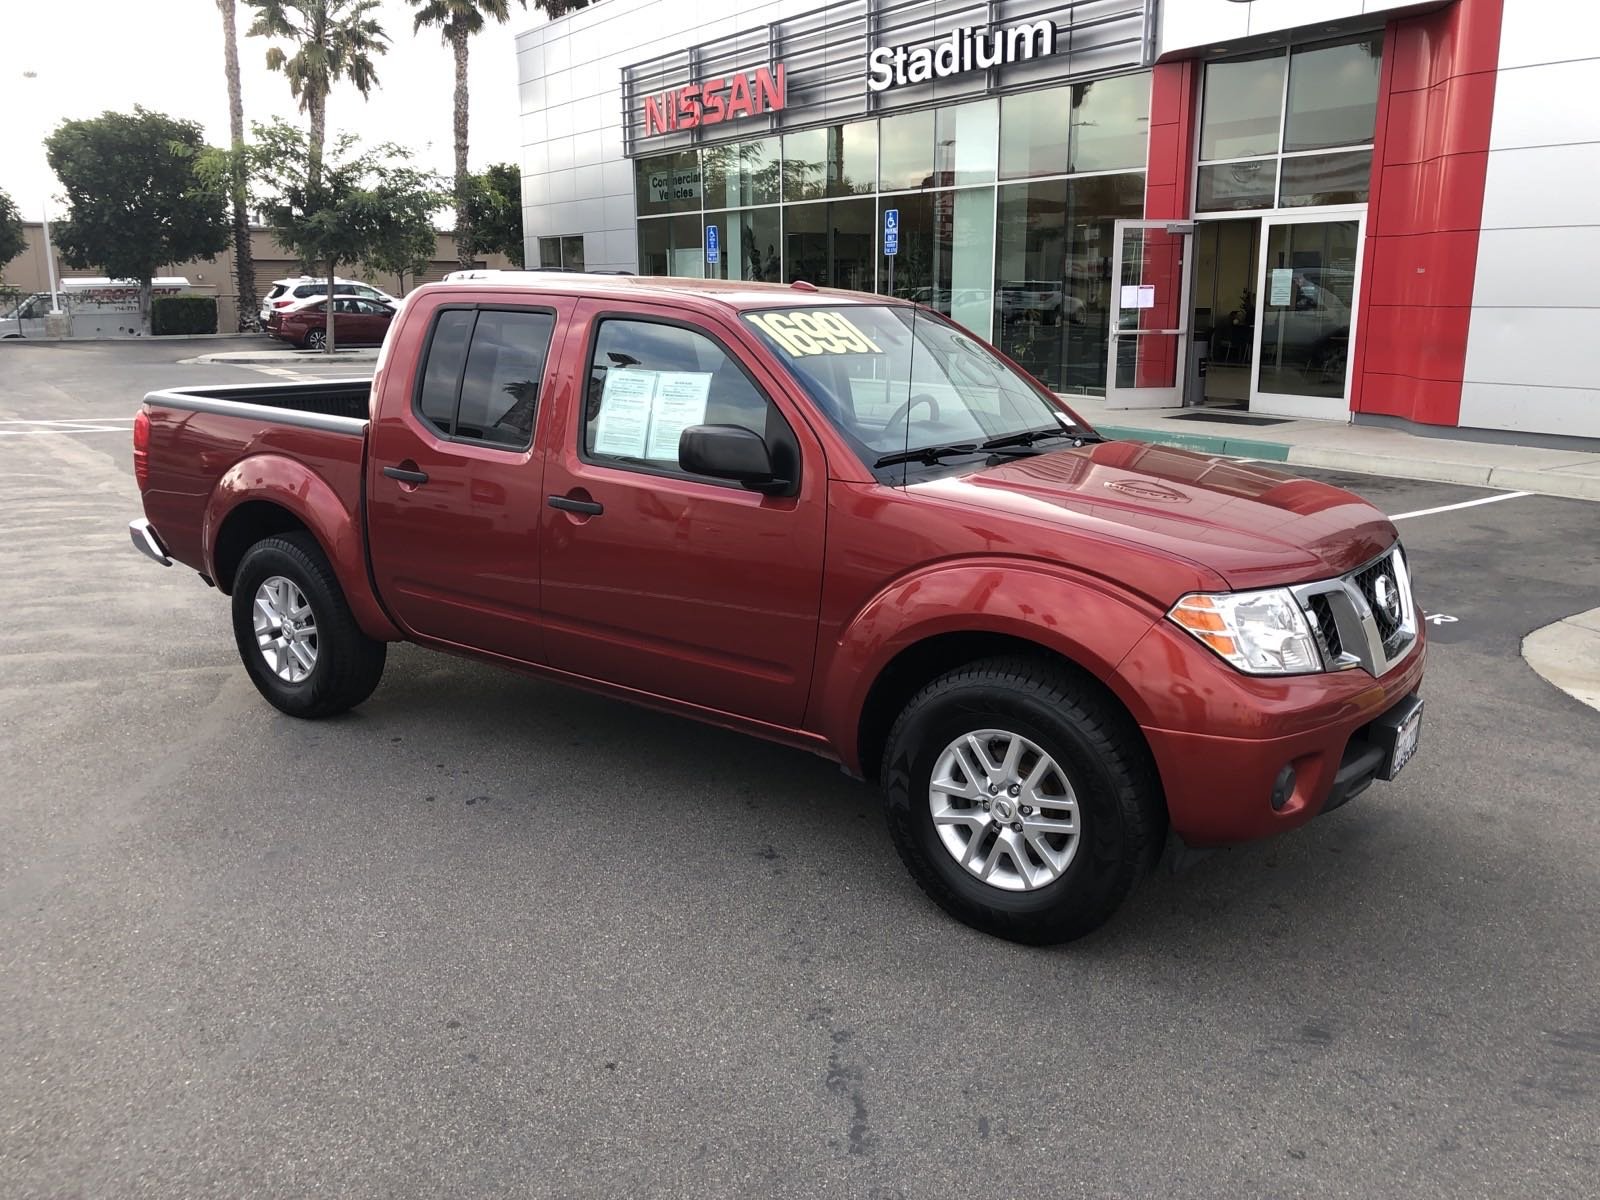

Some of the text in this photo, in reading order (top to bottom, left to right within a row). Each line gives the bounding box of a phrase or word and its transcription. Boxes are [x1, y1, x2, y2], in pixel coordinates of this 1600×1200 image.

[868, 19, 1056, 91] Stadium
[645, 63, 786, 138] NISSAN
[659, 187, 694, 200] Veicles
[744, 311, 884, 358] 16991
